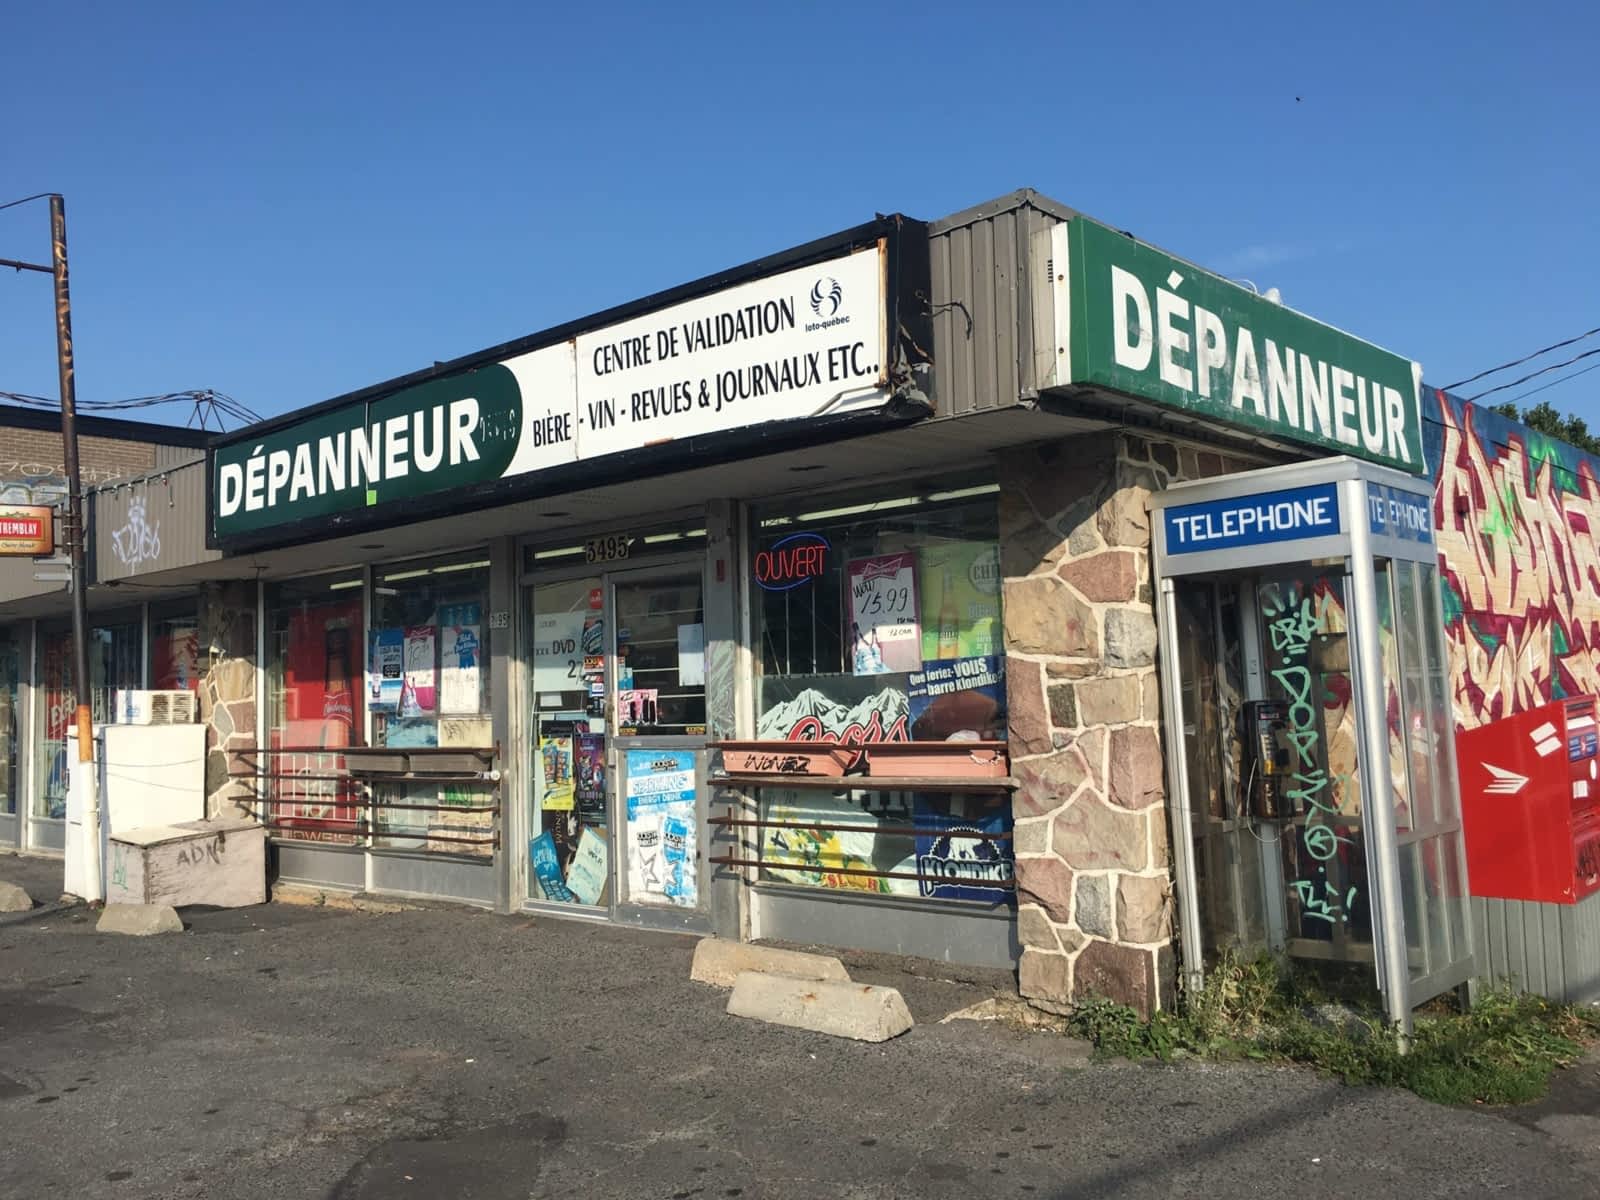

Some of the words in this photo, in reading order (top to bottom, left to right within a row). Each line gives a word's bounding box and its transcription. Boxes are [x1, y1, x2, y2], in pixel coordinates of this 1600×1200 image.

[593, 334, 652, 376] CENTRE
[657, 327, 679, 361] DE
[683, 295, 795, 353] VALIDATION
[1111, 265, 1412, 464] DÉPANNEUR
[533, 408, 572, 448] BIÈRE
[588, 398, 616, 431] VIN
[631, 380, 692, 422] REVUES
[698, 378, 711, 409] &
[715, 351, 821, 412] JOURNAUX
[219, 398, 481, 518] DÉPANNEUR
[1172, 496, 1333, 543] TELEPHONE
[1368, 495, 1429, 532] TEEPHONE
[586, 536, 628, 562] 3495
[755, 545, 828, 582] OUVERT
[861, 587, 908, 614] 15.99
[552, 640, 576, 655] DVD
[927, 680, 955, 696] barre
[786, 708, 909, 754] Cors
[923, 857, 1012, 894] KLONDIKE
